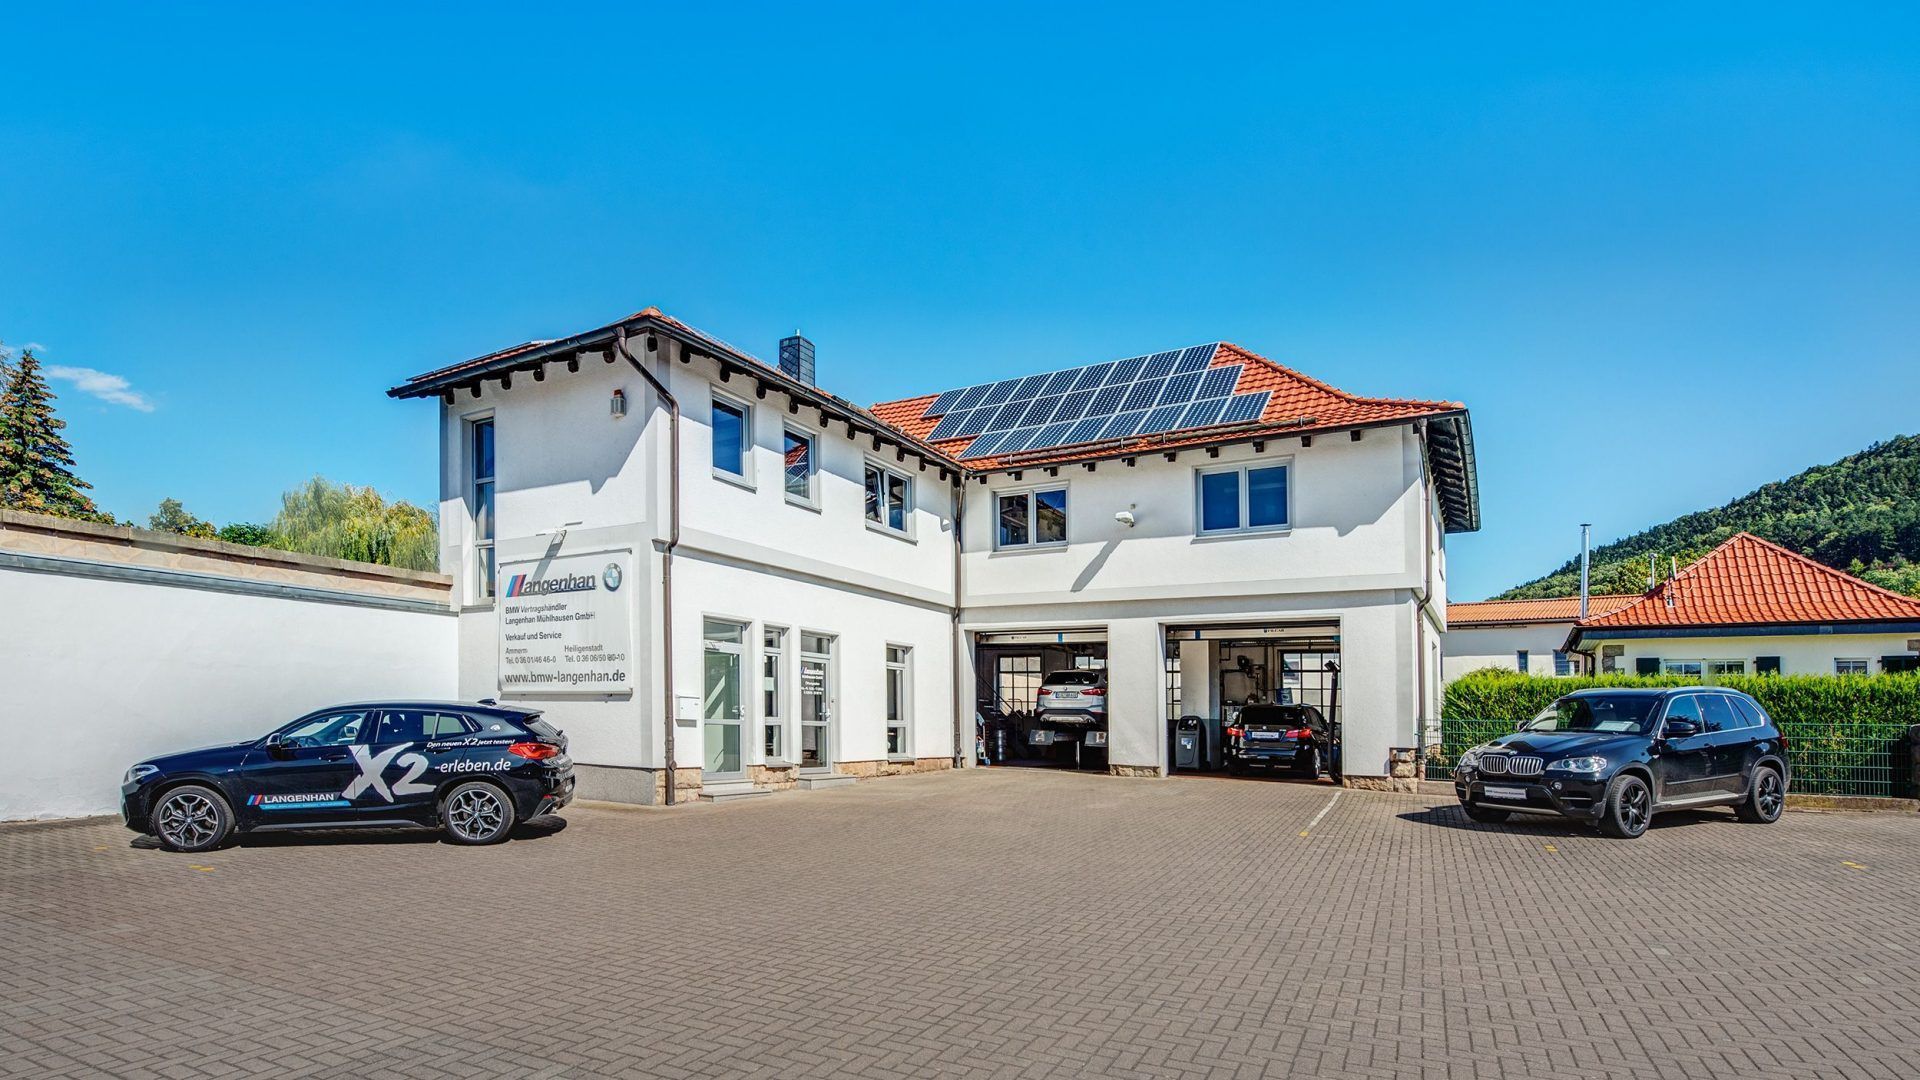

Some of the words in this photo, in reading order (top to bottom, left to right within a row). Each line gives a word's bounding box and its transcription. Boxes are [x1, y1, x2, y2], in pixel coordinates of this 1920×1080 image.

[505, 606, 520, 615] BMW
[521, 602, 568, 614] Vertragshändler
[505, 615, 536, 627] Langenhan
[536, 613, 574, 623] Mühlhausen
[574, 611, 596, 621] GmbH
[505, 632, 526, 641] Verkauf
[527, 631, 539, 640] und
[539, 631, 562, 640] Service
[564, 644, 604, 654] Heiligenstadt
[565, 654, 576, 663] Tel.
[504, 670, 626, 685] www.bmw-langenhan.de
[426, 741, 440, 749] Den
[462, 737, 478, 747] X2
[341, 741, 437, 803] X2
[264, 793, 335, 804] LANGENHAN
